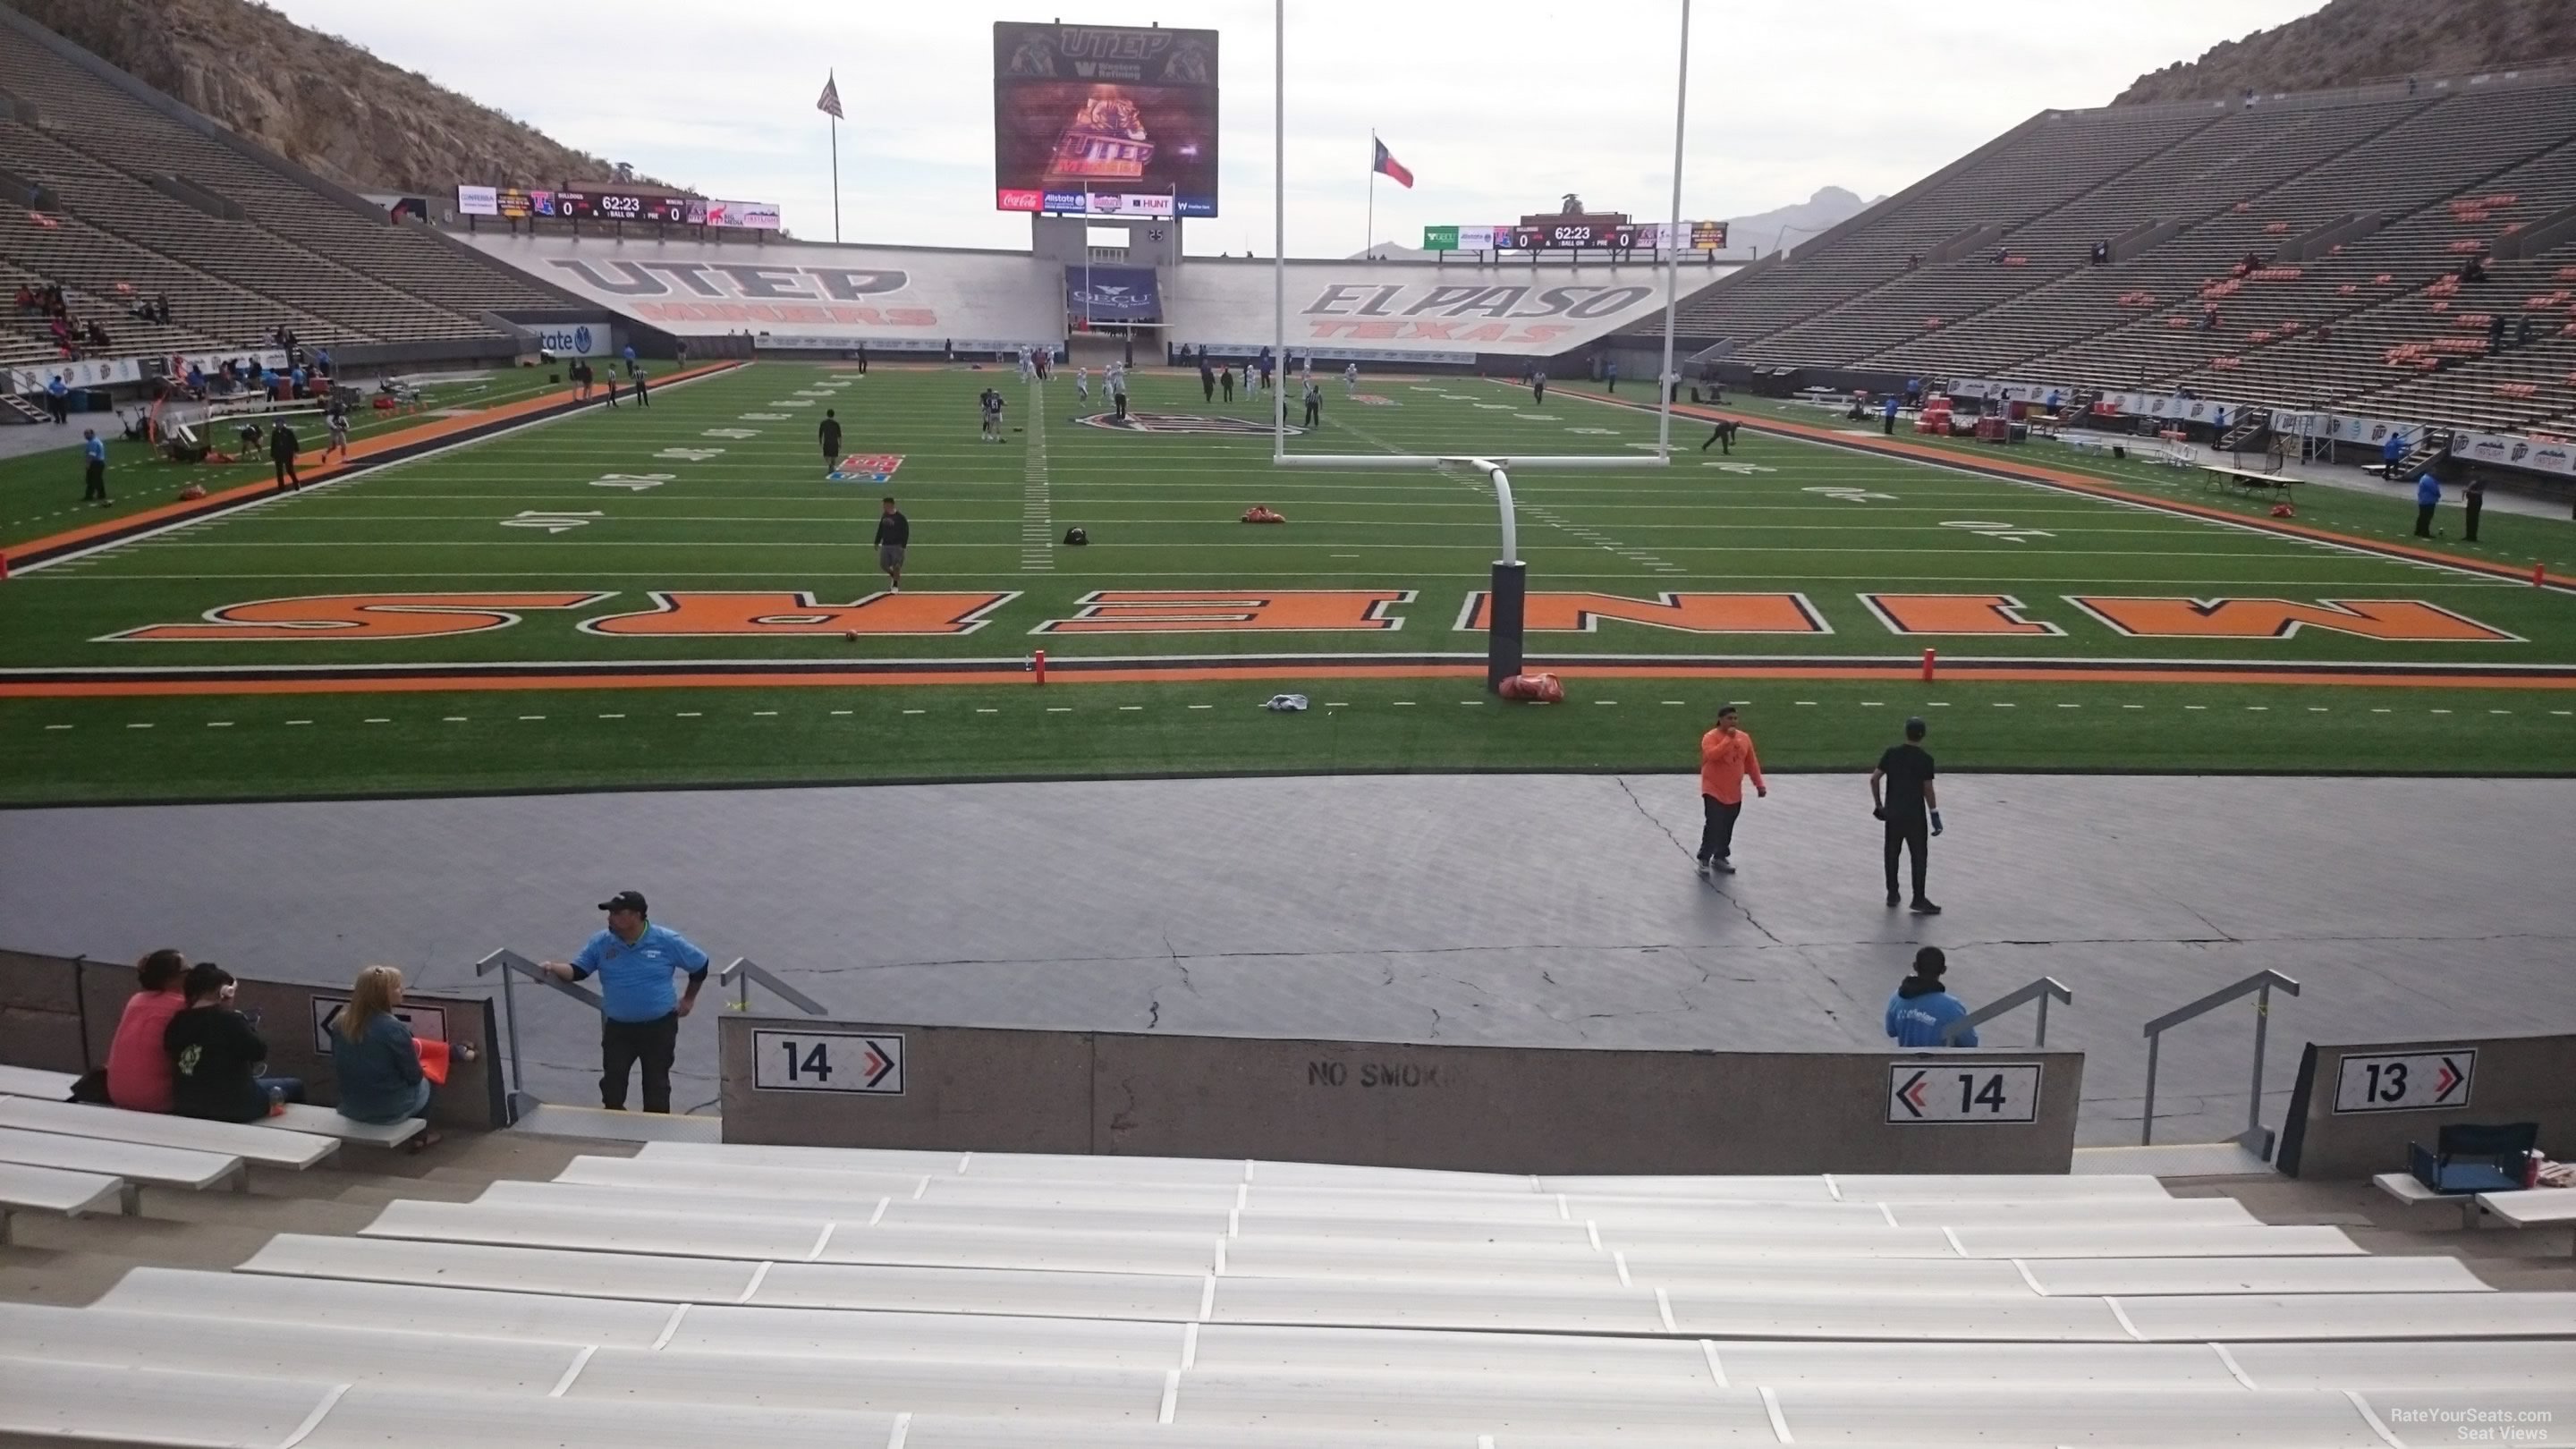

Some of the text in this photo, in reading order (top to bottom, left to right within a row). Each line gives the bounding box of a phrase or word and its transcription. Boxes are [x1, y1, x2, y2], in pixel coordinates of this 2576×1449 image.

[1061, 28, 1173, 59] UTEP
[1098, 63, 1140, 71] Western
[1098, 71, 1140, 80] Refining
[602, 196, 640, 211] 62:23
[1045, 194, 1074, 203] Allstate
[1143, 199, 1169, 208] HUNT
[563, 202, 572, 216] 0
[671, 208, 680, 220] 0
[1148, 230, 1163, 241] 25
[1555, 227, 1590, 239] 62:23
[1620, 233, 1629, 246] 0
[1520, 235, 1528, 247] 0
[545, 258, 911, 301] UTEP
[1074, 291, 1148, 304] GECU
[1299, 284, 1656, 320] EL PASO
[628, 302, 937, 327] MINERS
[1309, 319, 1575, 343] TEXAS
[499, 511, 605, 528] 10
[1938, 521, 2058, 537] 10
[88, 589, 2529, 642] MINERS
[782, 1041, 832, 1081] 14
[1309, 1061, 1460, 1089] NO SMOK
[2366, 1063, 2408, 1102] 13
[1958, 1074, 2005, 1113] 14
